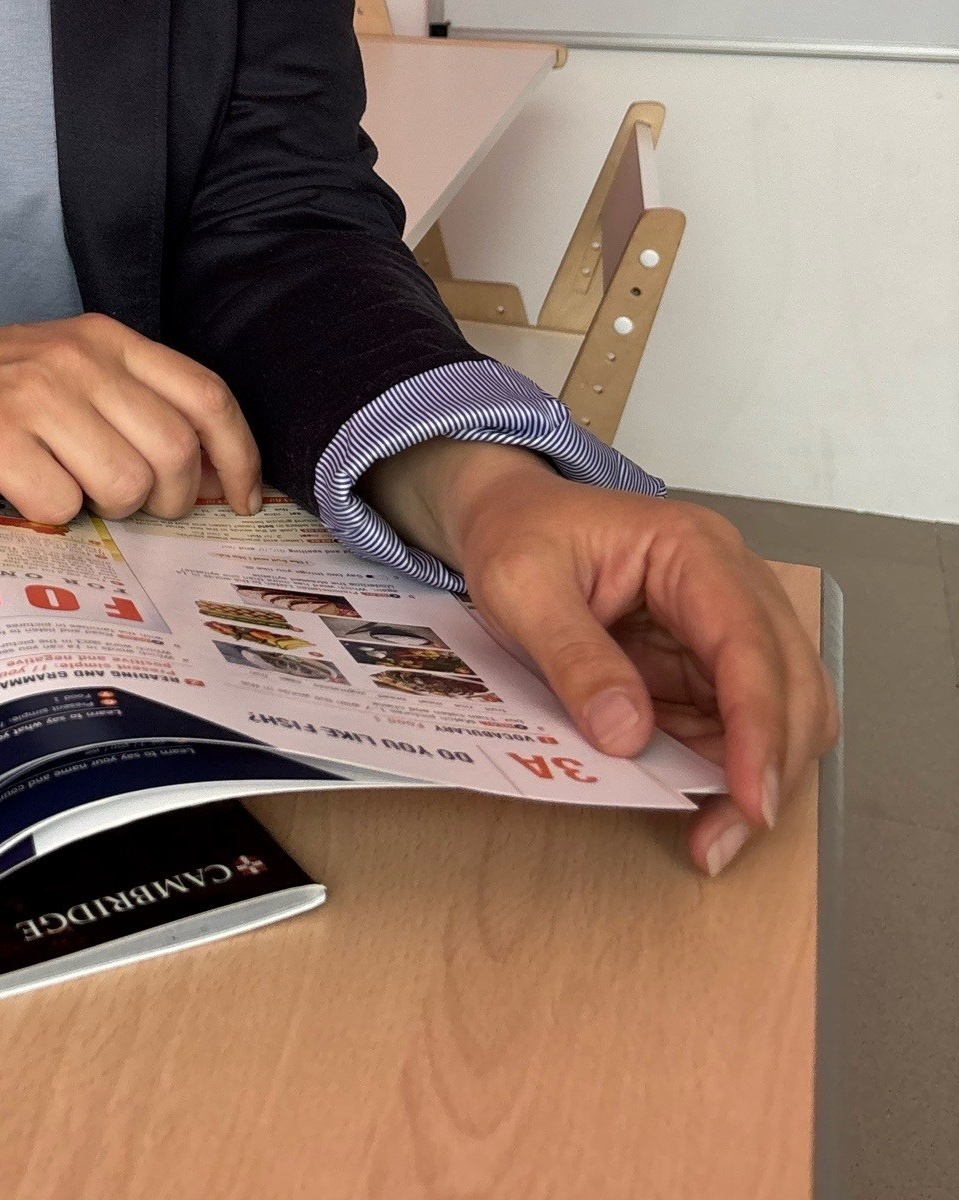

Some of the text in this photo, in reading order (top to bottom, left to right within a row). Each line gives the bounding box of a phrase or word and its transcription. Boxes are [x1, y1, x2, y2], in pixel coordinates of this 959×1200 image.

[62, 578, 128, 594] FOR
[74, 670, 104, 678] AND
[110, 670, 180, 684] READING
[69, 713, 82, 721] to
[86, 709, 123, 719] Learn
[46, 715, 66, 728] say
[248, 712, 318, 734] FISH?
[14, 723, 43, 737] what
[320, 725, 377, 748] LIKE
[435, 725, 535, 743] VOCABULARY
[144, 750, 156, 759] to
[160, 747, 195, 755] Learn
[381, 738, 434, 758] YOU
[91, 754, 117, 768] your
[120, 750, 140, 762] say
[436, 748, 474, 764] DO
[53, 761, 88, 777] name
[507, 752, 599, 784] 3A
[28, 774, 50, 788] and
[15, 863, 233, 942] CAMBRIDGE
